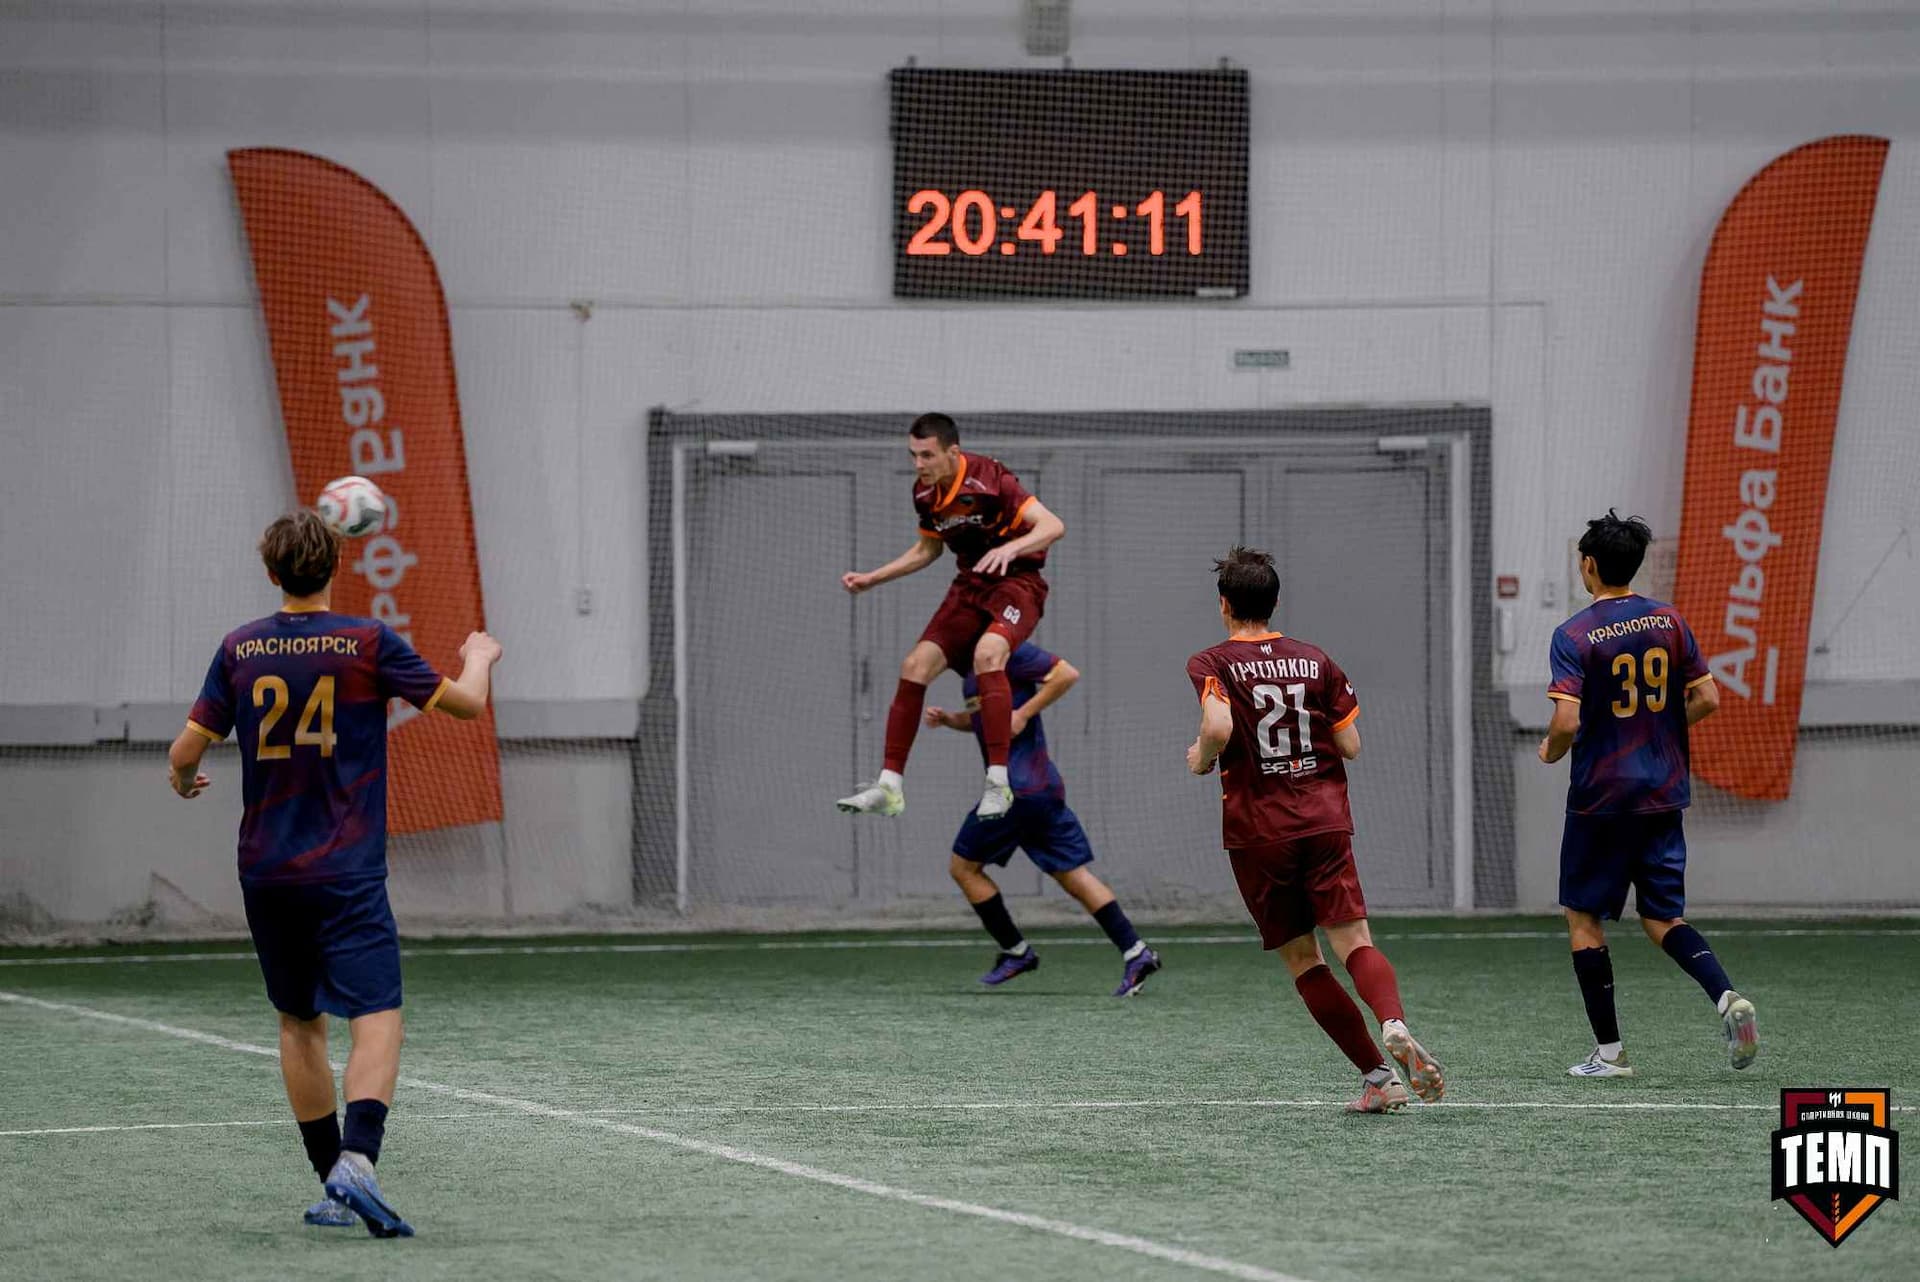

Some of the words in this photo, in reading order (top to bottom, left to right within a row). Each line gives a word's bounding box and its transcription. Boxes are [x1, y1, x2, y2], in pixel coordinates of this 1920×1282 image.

[906, 190, 1203, 257] 20:41:11
[1735, 275, 1804, 452] Банк
[1711, 471, 1782, 699] Альфа
[236, 636, 358, 660] КРАСНОЯРСК
[1587, 616, 1674, 645] КРАСНОЯРСК
[253, 675, 337, 761] 24
[1611, 647, 1669, 719] 39
[1252, 683, 1312, 758] 21
